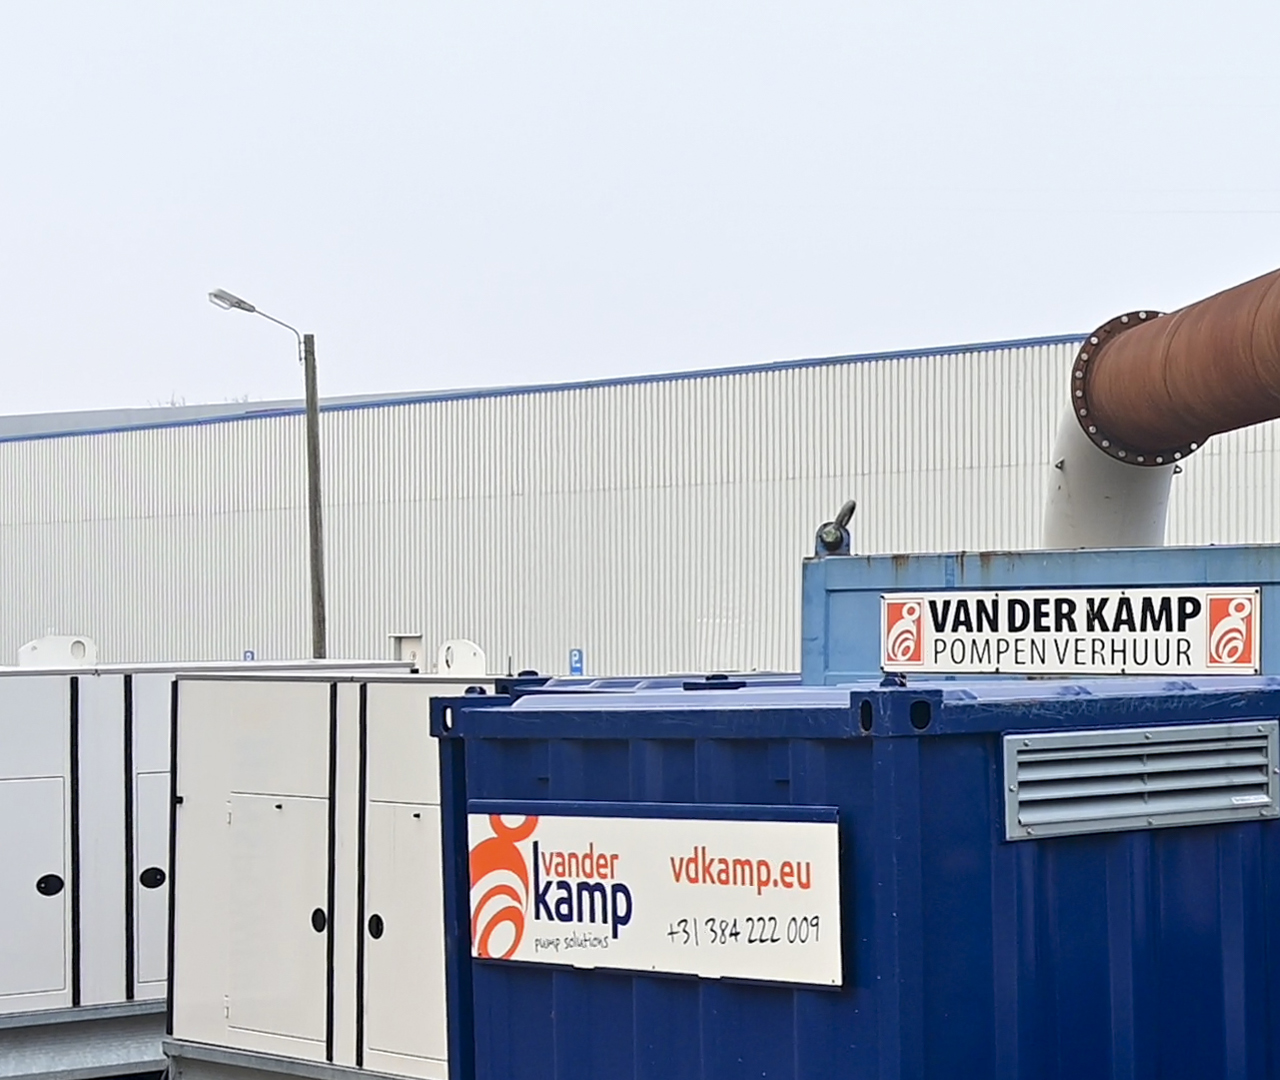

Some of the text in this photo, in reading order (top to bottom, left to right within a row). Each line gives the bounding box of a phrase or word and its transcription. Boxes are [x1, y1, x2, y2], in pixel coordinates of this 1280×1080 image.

[928, 597, 1202, 633] VAN DER KAMP
[670, 845, 812, 896] vdkamp.eu
[533, 841, 633, 939] kamp
[534, 930, 609, 953] pump solutions
[667, 915, 820, 946] +31 384 222 009
